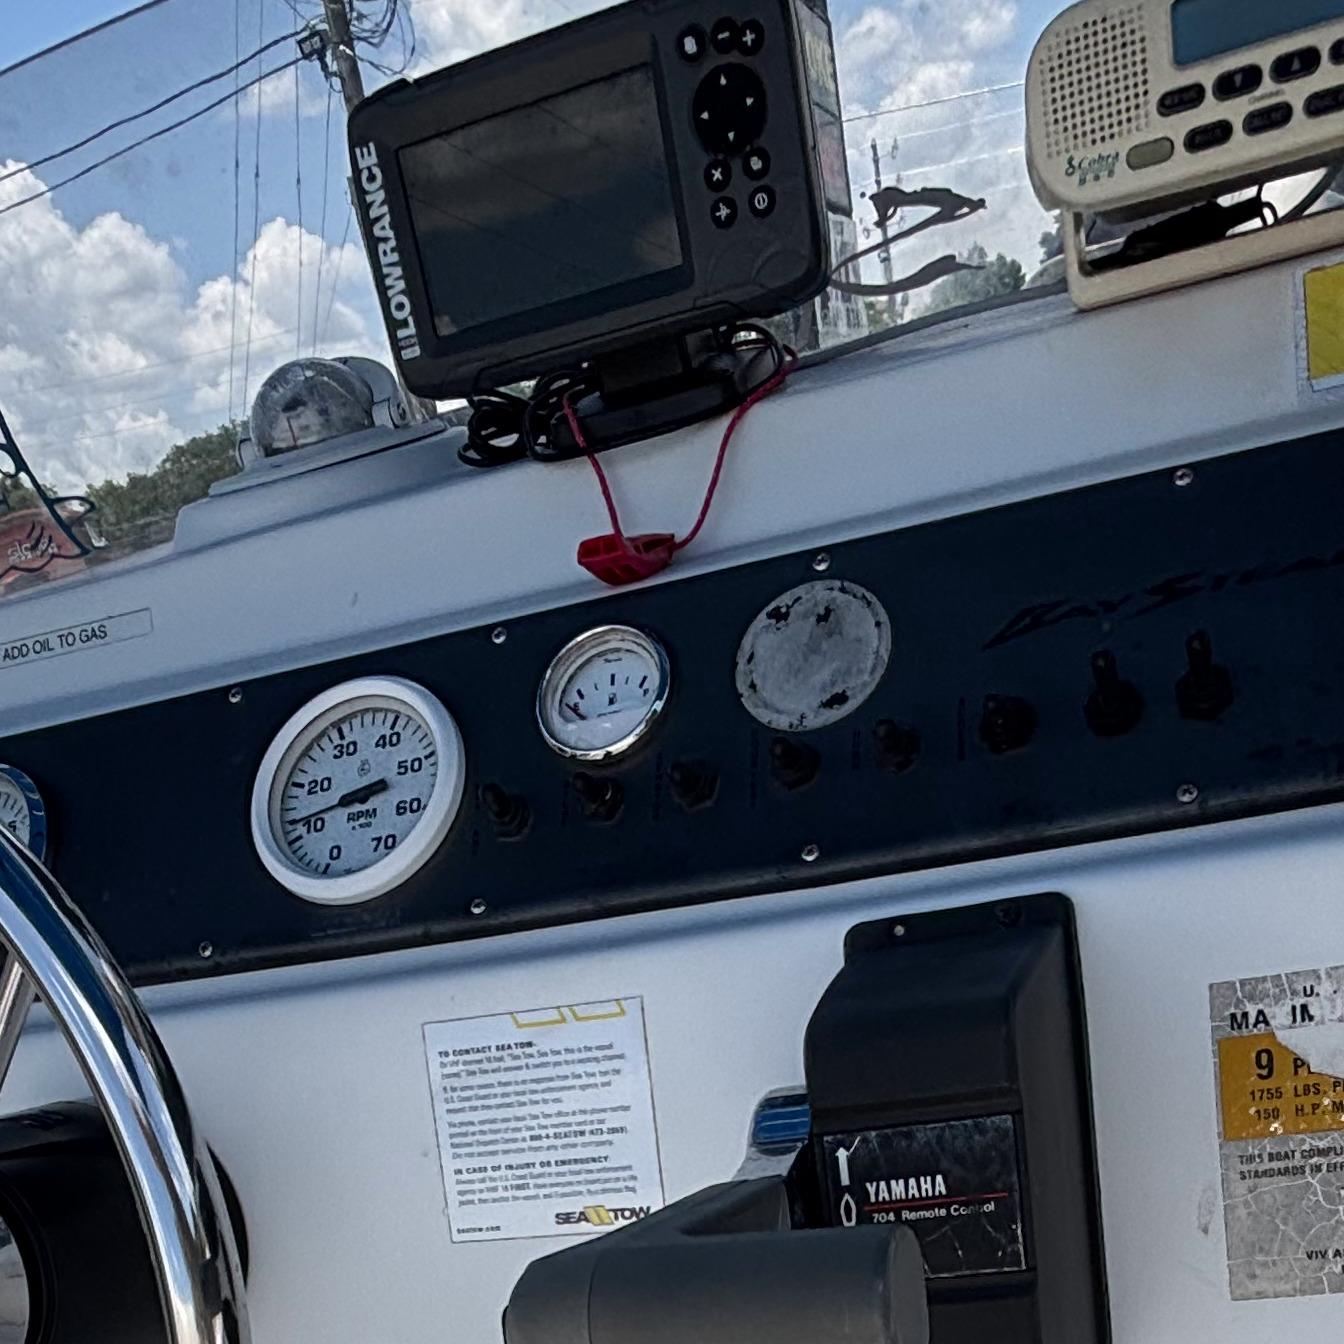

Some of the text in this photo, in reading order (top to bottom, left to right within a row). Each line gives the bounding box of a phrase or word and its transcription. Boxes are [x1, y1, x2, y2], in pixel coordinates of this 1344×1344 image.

[355, 141, 418, 340] LOWRANCE
[3, 644, 31, 662] ADD
[32, 638, 55, 655] OIL
[57, 631, 77, 649] TO
[79, 625, 108, 645] GAS
[332, 740, 358, 760] 30
[374, 731, 401, 750] 40
[396, 757, 423, 776] 50
[306, 777, 332, 796] 20
[346, 808, 378, 824] RPM
[395, 797, 422, 816] 60
[302, 817, 326, 835] 10
[371, 833, 397, 852] 70
[329, 844, 342, 861] 0
[1255, 1047, 1276, 1080] 9
[1249, 1086, 1284, 1102] 1755
[1254, 1106, 1281, 1121] 150
[1238, 1153, 1264, 1166] THIS
[1267, 1150, 1297, 1163] BOAT
[1239, 1165, 1307, 1181] STANDARDS
[1310, 1164, 1323, 1174] IN
[865, 1174, 948, 1203] YAMAHA
[555, 1206, 651, 1226] SEA TOW
[872, 1211, 896, 1224] 704
[901, 1207, 948, 1222] Remote
